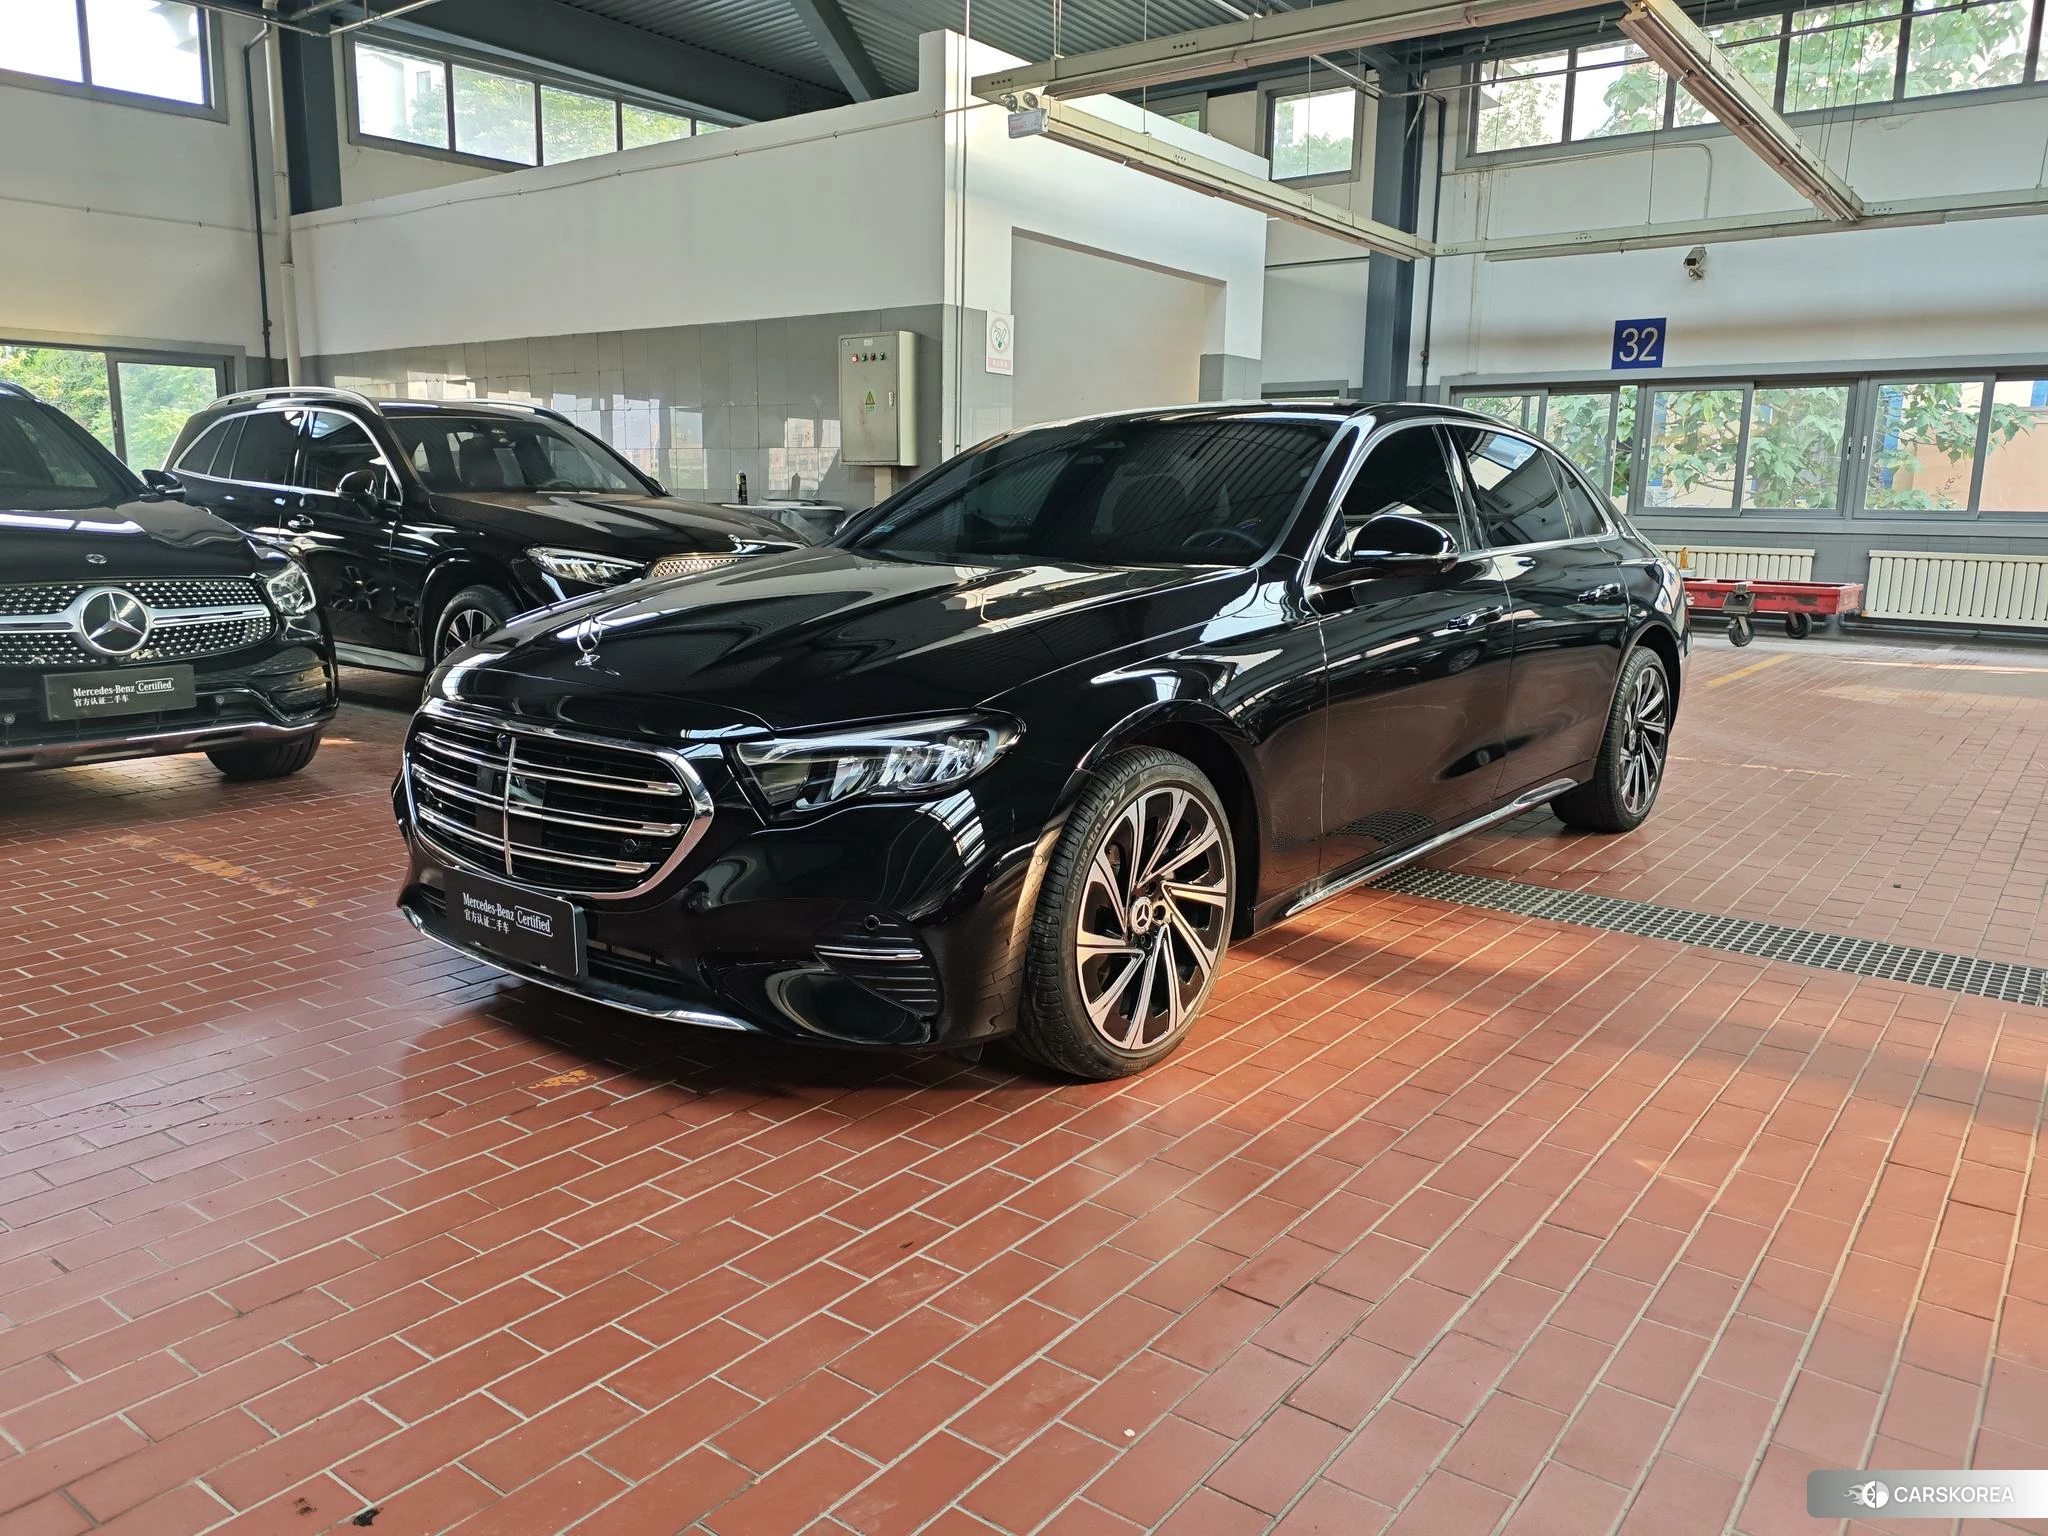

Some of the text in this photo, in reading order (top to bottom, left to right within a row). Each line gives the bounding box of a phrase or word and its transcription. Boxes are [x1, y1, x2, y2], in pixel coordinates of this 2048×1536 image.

[1619, 327, 1659, 362] 32
[72, 679, 172, 698] Mercedes-Benz Certified
[74, 694, 130, 708] 官方认证二手车
[462, 892, 551, 933] Mercedes-Benz Certified
[463, 908, 510, 935] 官方认证二手车
